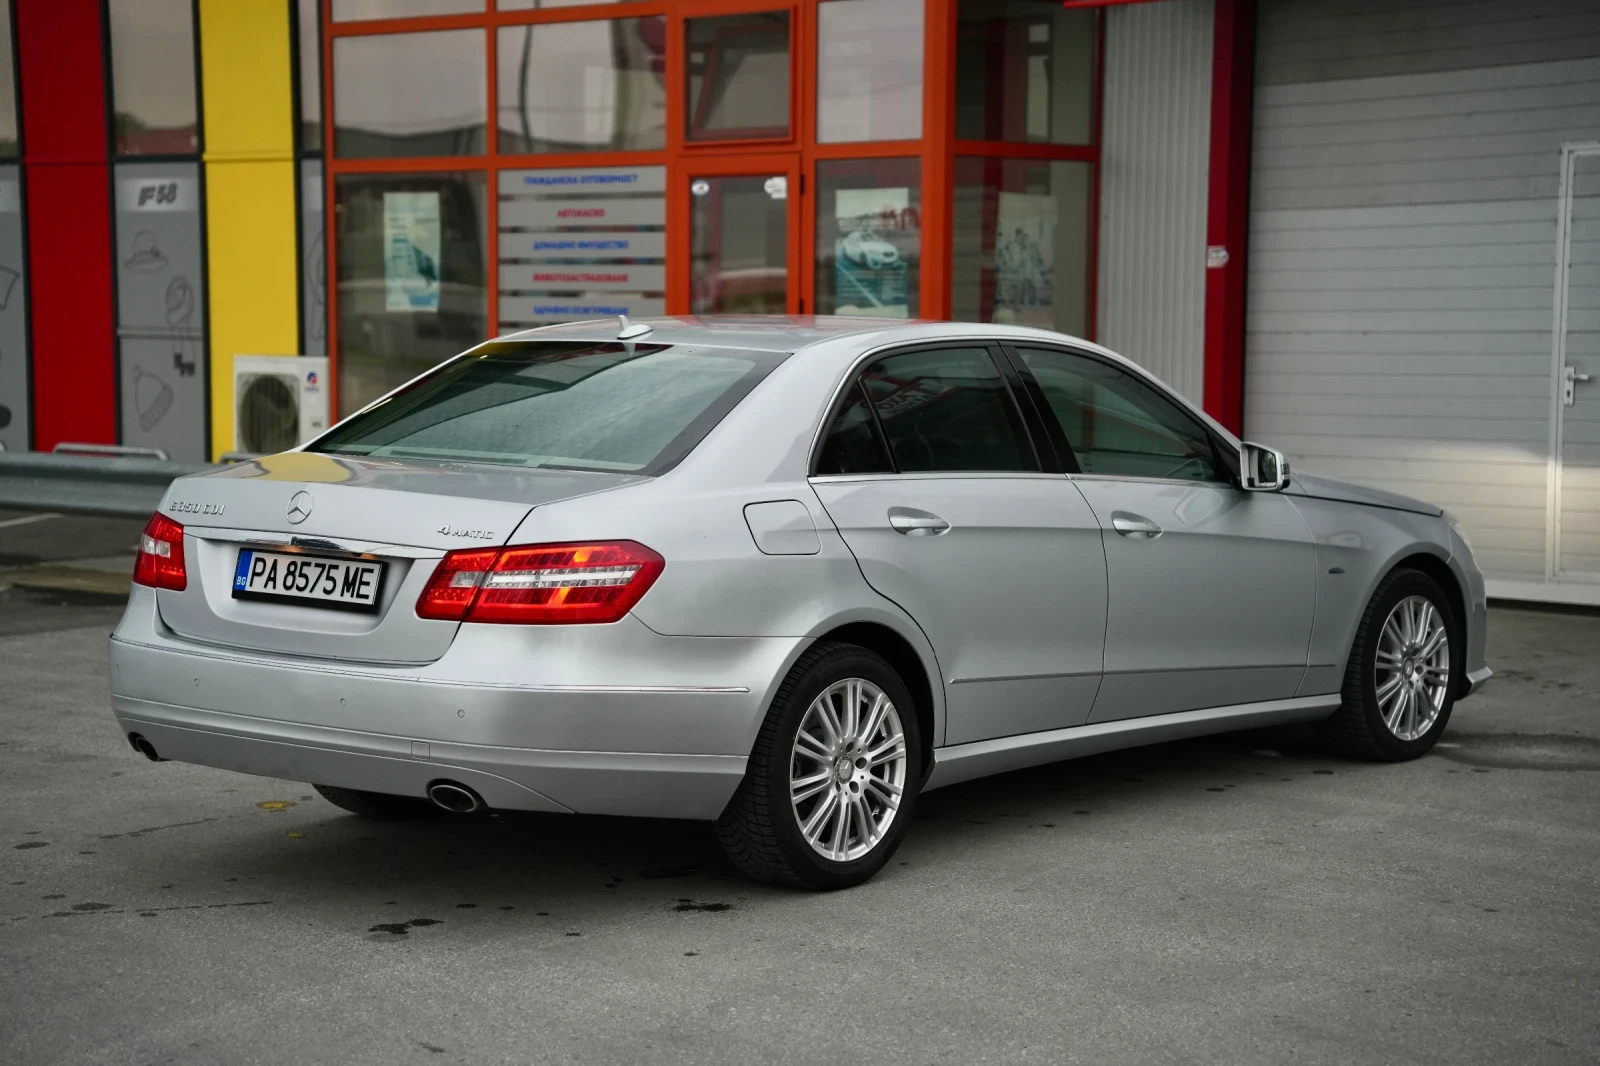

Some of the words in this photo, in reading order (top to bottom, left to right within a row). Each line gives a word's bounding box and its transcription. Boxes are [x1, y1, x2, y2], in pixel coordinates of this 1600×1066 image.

[169, 501, 201, 514] E350
[202, 504, 225, 516] CDI
[236, 576, 247, 586] BG
[249, 556, 279, 590] PA
[282, 560, 339, 596] 8575
[340, 565, 375, 600] ME
